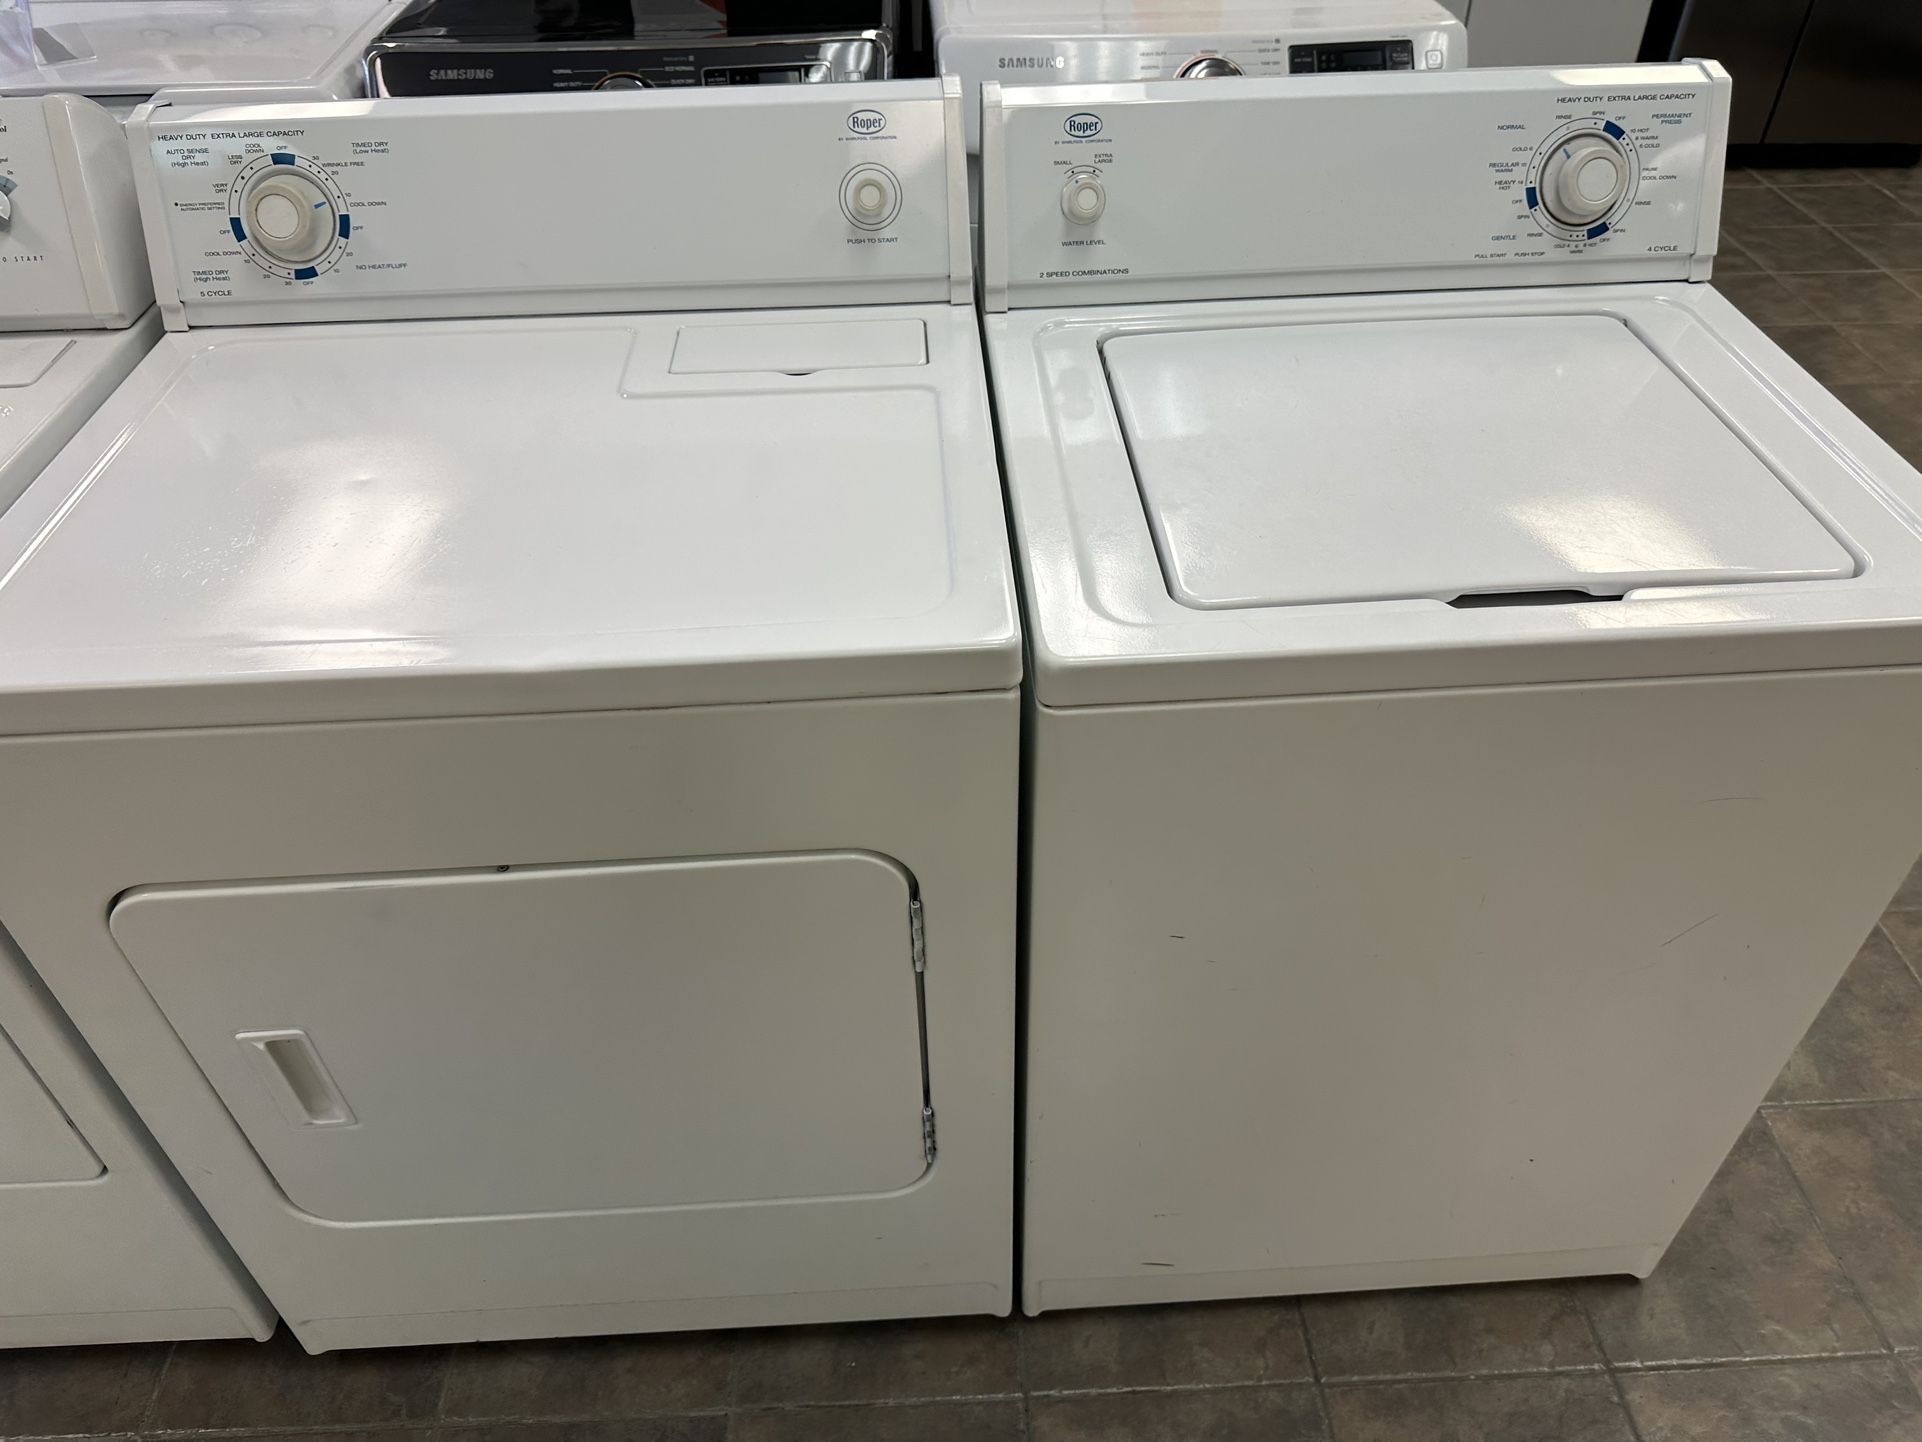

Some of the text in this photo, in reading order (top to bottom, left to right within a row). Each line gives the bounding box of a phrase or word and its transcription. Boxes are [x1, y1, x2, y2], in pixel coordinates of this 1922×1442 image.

[998, 56, 1064, 69] SAMSUNG
[430, 69, 493, 81] SAMSUNG
[1557, 96, 1582, 104] HEAVY
[852, 116, 882, 132] Roper
[1069, 120, 1099, 135] Roper
[238, 131, 264, 139] LARGE
[266, 130, 304, 138] CAPACITY
[1072, 269, 1129, 277] COMBINATIONS
